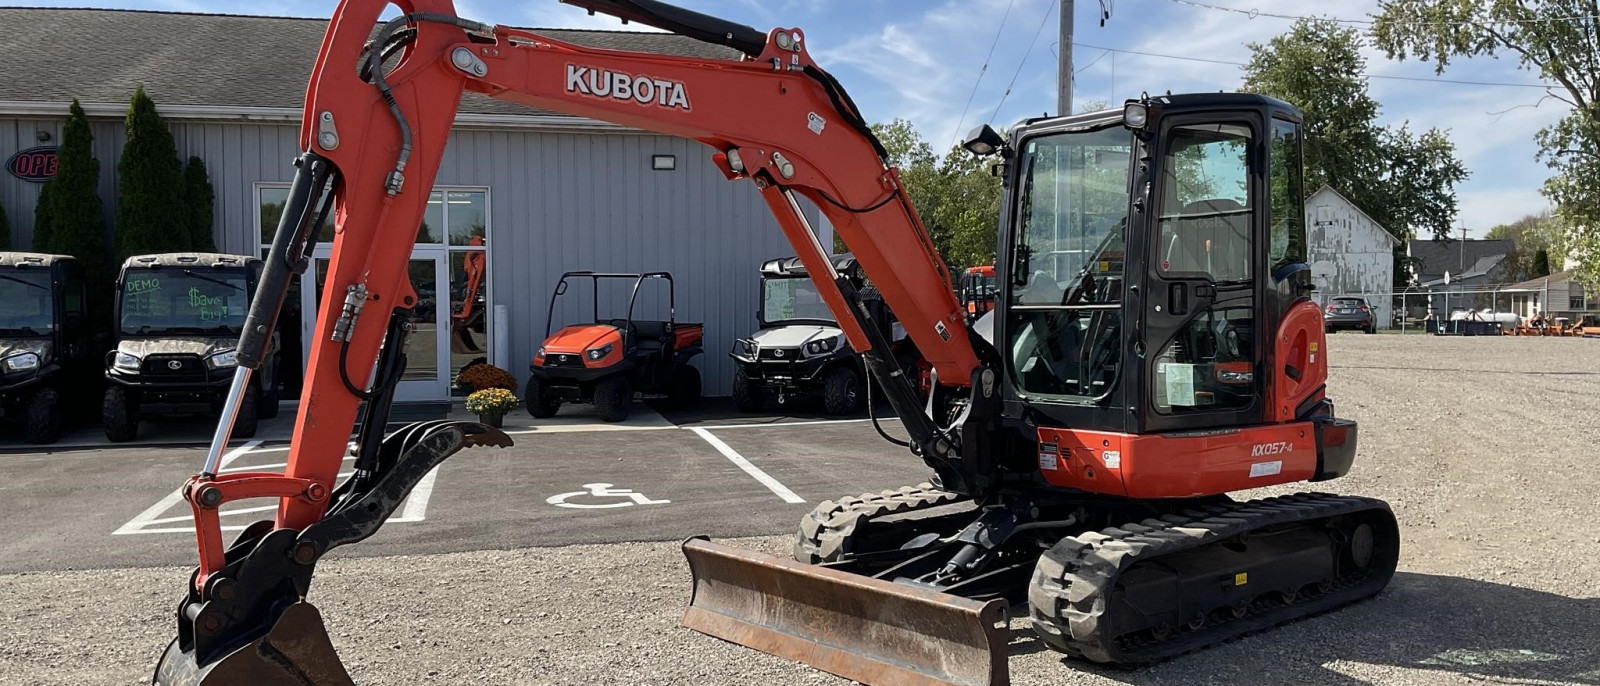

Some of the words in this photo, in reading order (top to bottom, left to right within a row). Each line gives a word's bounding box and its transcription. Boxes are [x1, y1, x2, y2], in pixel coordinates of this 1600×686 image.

[566, 64, 689, 109] KUBOTA
[16, 154, 60, 176] OPE
[127, 279, 159, 292] DEMO
[1251, 442, 1293, 457] KX057-4
